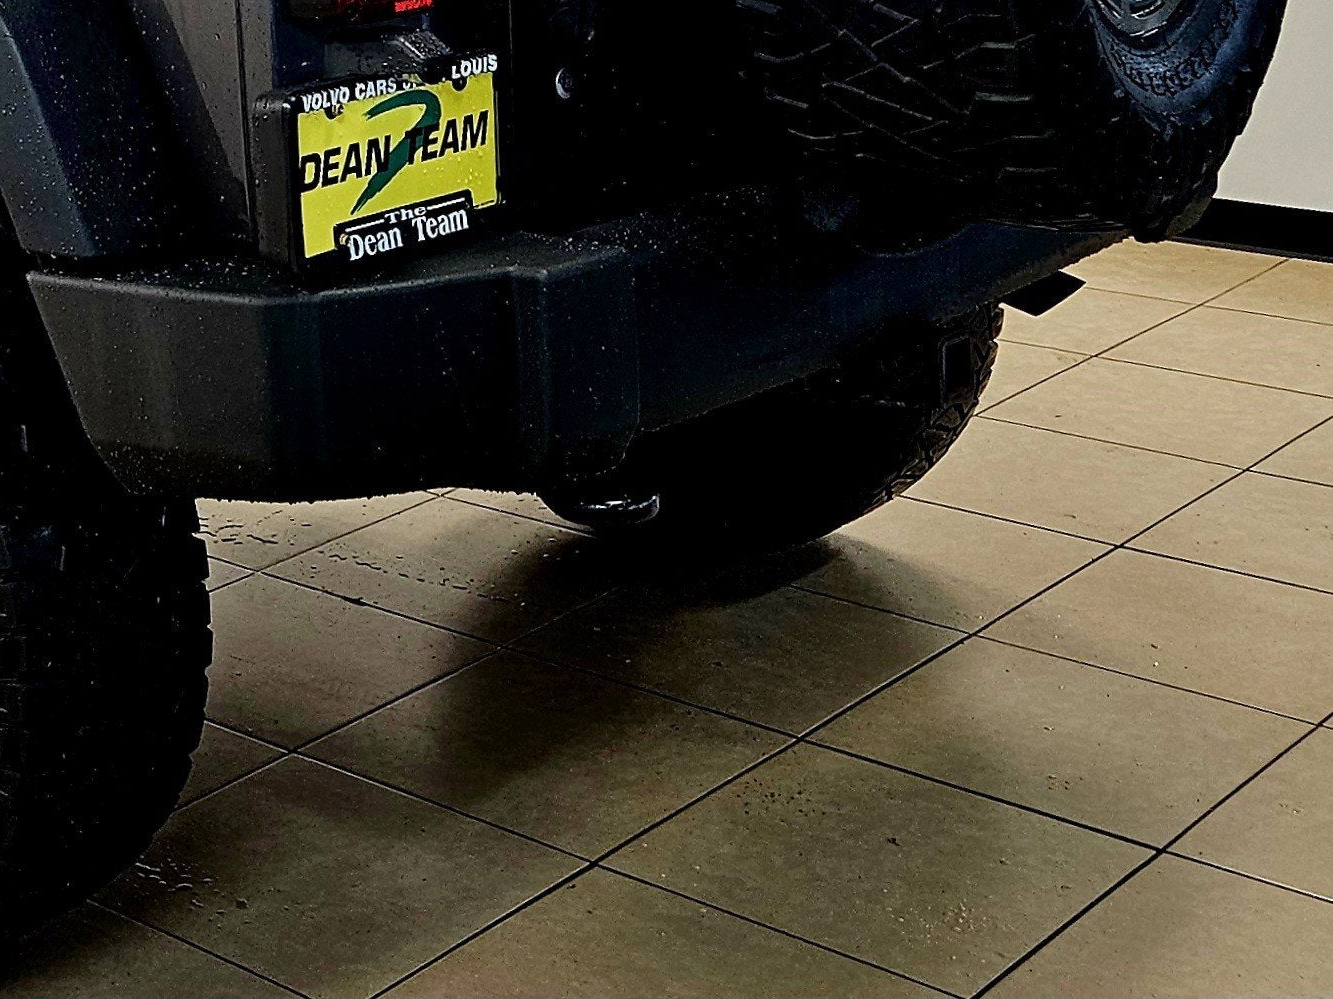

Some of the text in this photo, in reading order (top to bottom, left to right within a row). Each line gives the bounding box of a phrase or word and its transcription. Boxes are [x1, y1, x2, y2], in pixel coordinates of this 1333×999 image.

[451, 54, 498, 79] LOUIS
[301, 86, 350, 112] VOLVO
[355, 77, 397, 101] CARS
[300, 110, 489, 192] DEAN TEAM
[384, 206, 427, 224] The
[347, 209, 469, 261] Dean Team
